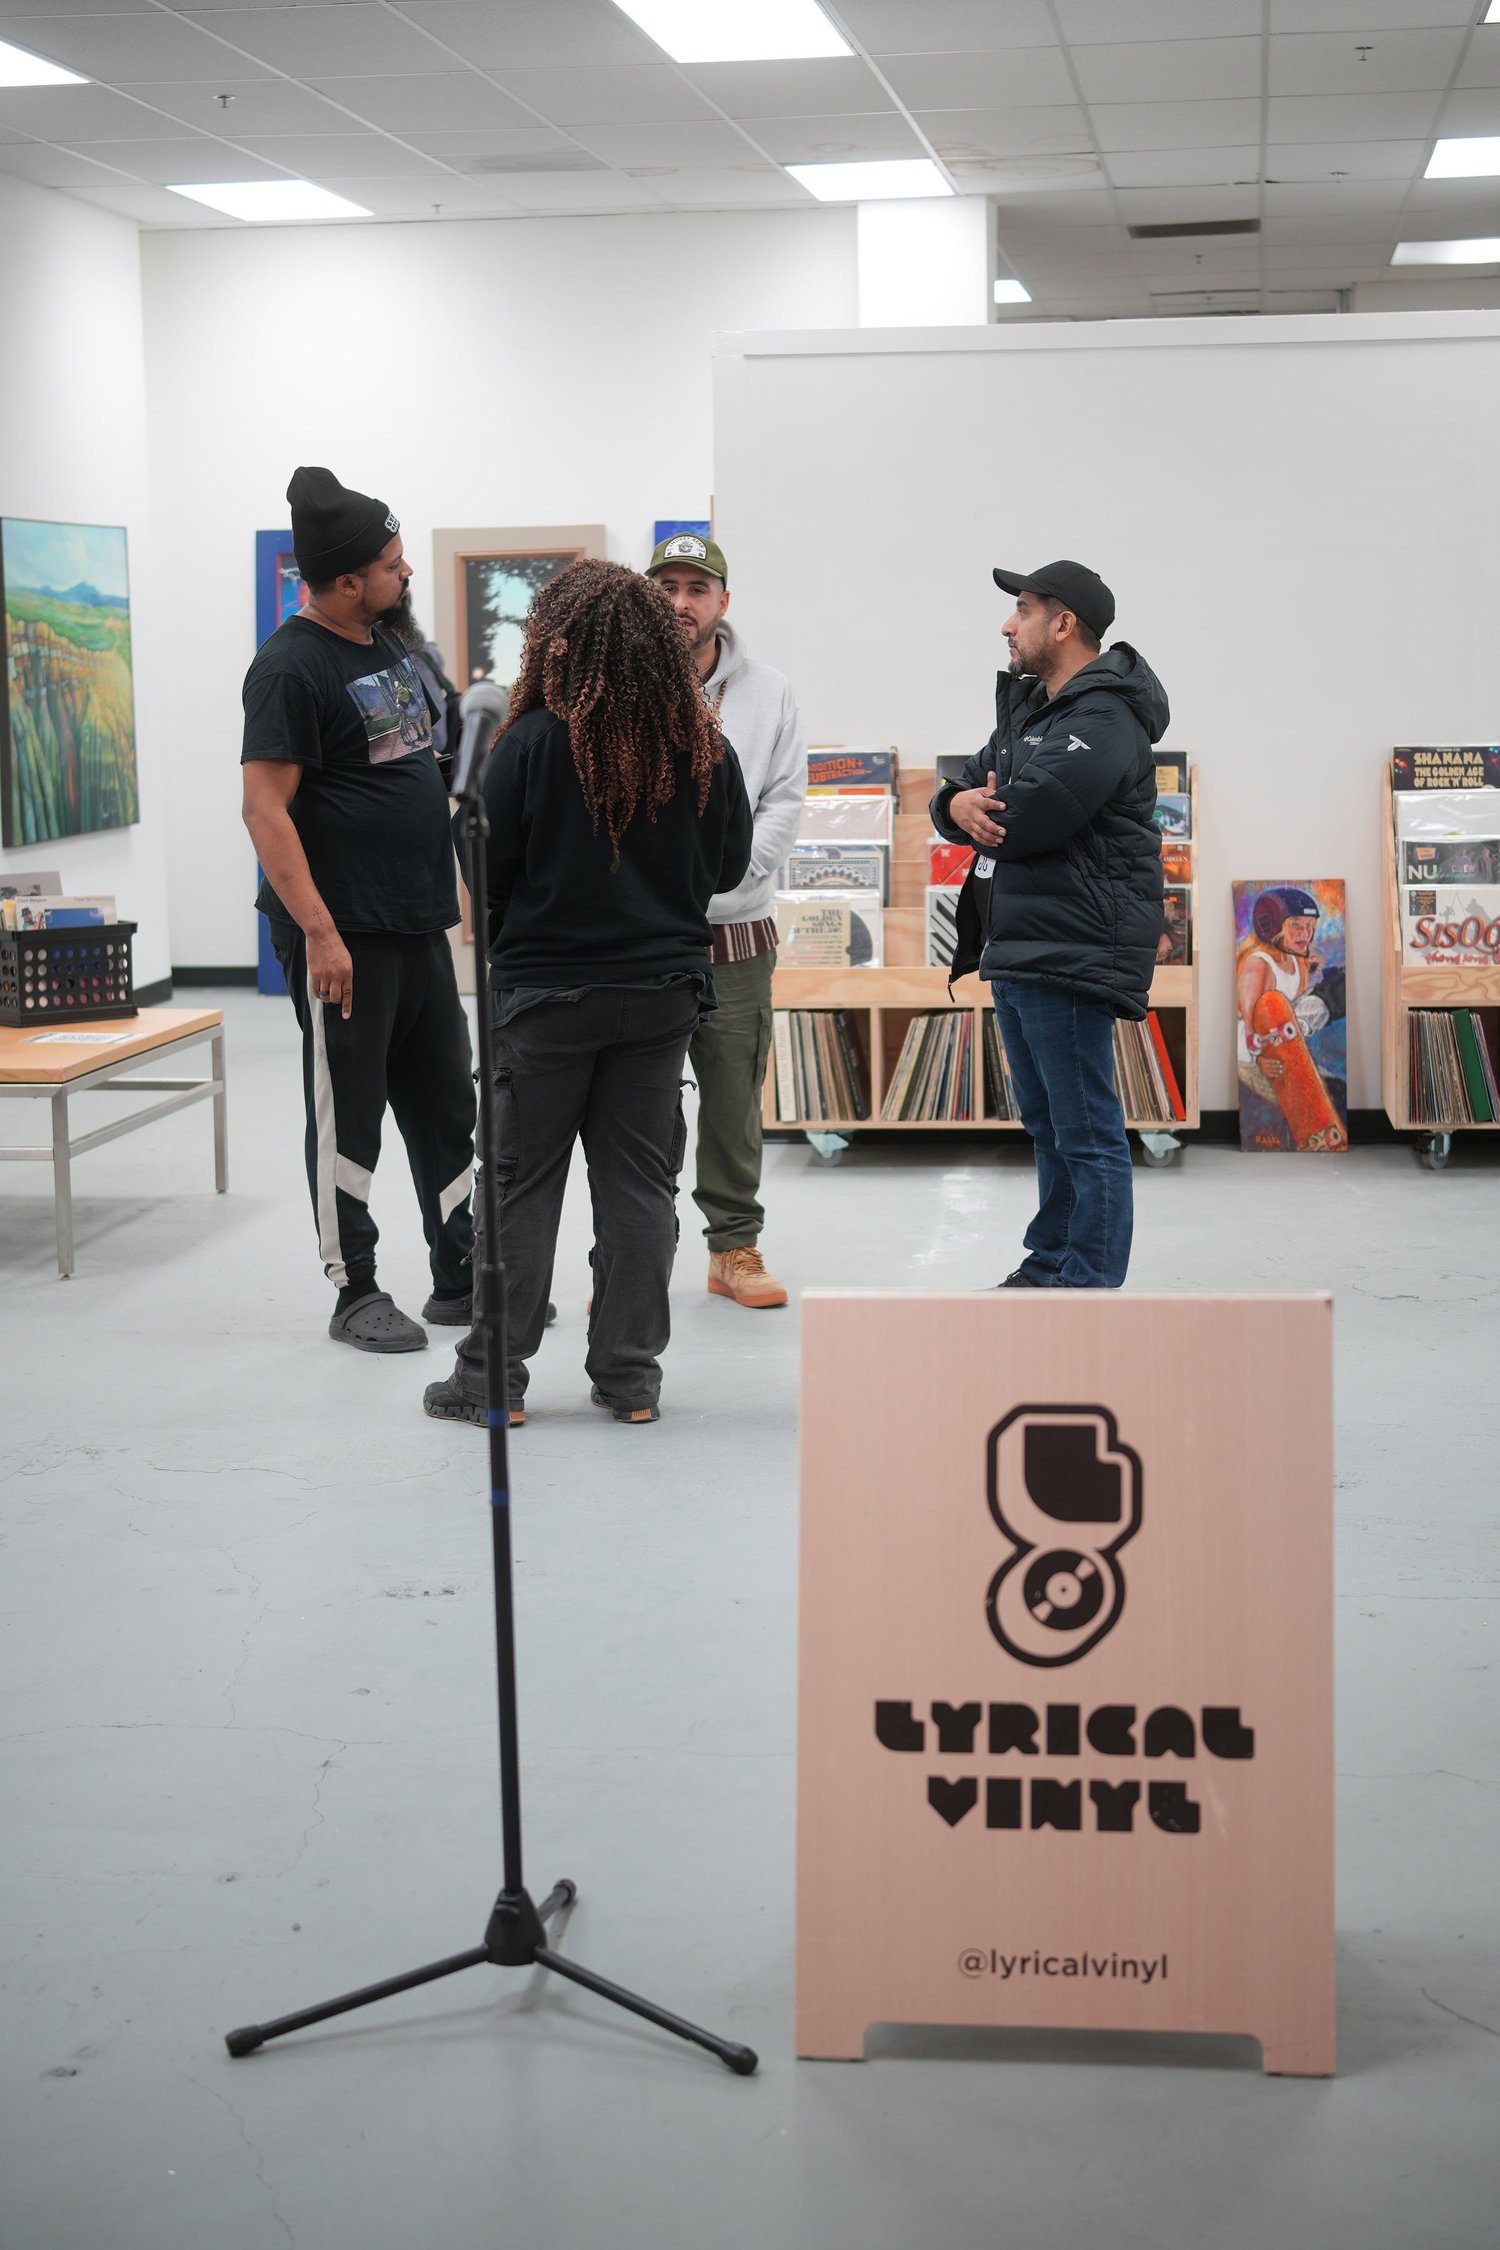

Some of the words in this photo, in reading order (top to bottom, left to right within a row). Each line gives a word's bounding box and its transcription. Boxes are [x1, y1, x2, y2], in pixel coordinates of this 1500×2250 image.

[1414, 767, 1431, 776] THE
[1432, 767, 1464, 777] GOLDEN
[1466, 767, 1484, 776] AGE
[1414, 777, 1425, 787] OF
[1427, 777, 1450, 787] ROCK
[1462, 777, 1484, 787] ROLL
[1408, 864, 1437, 880] NU
[875, 1700, 1255, 1760] LYRICAL
[927, 1776, 1201, 1835] VINYL
[958, 1948, 1168, 1983] @lyricalvinyl
